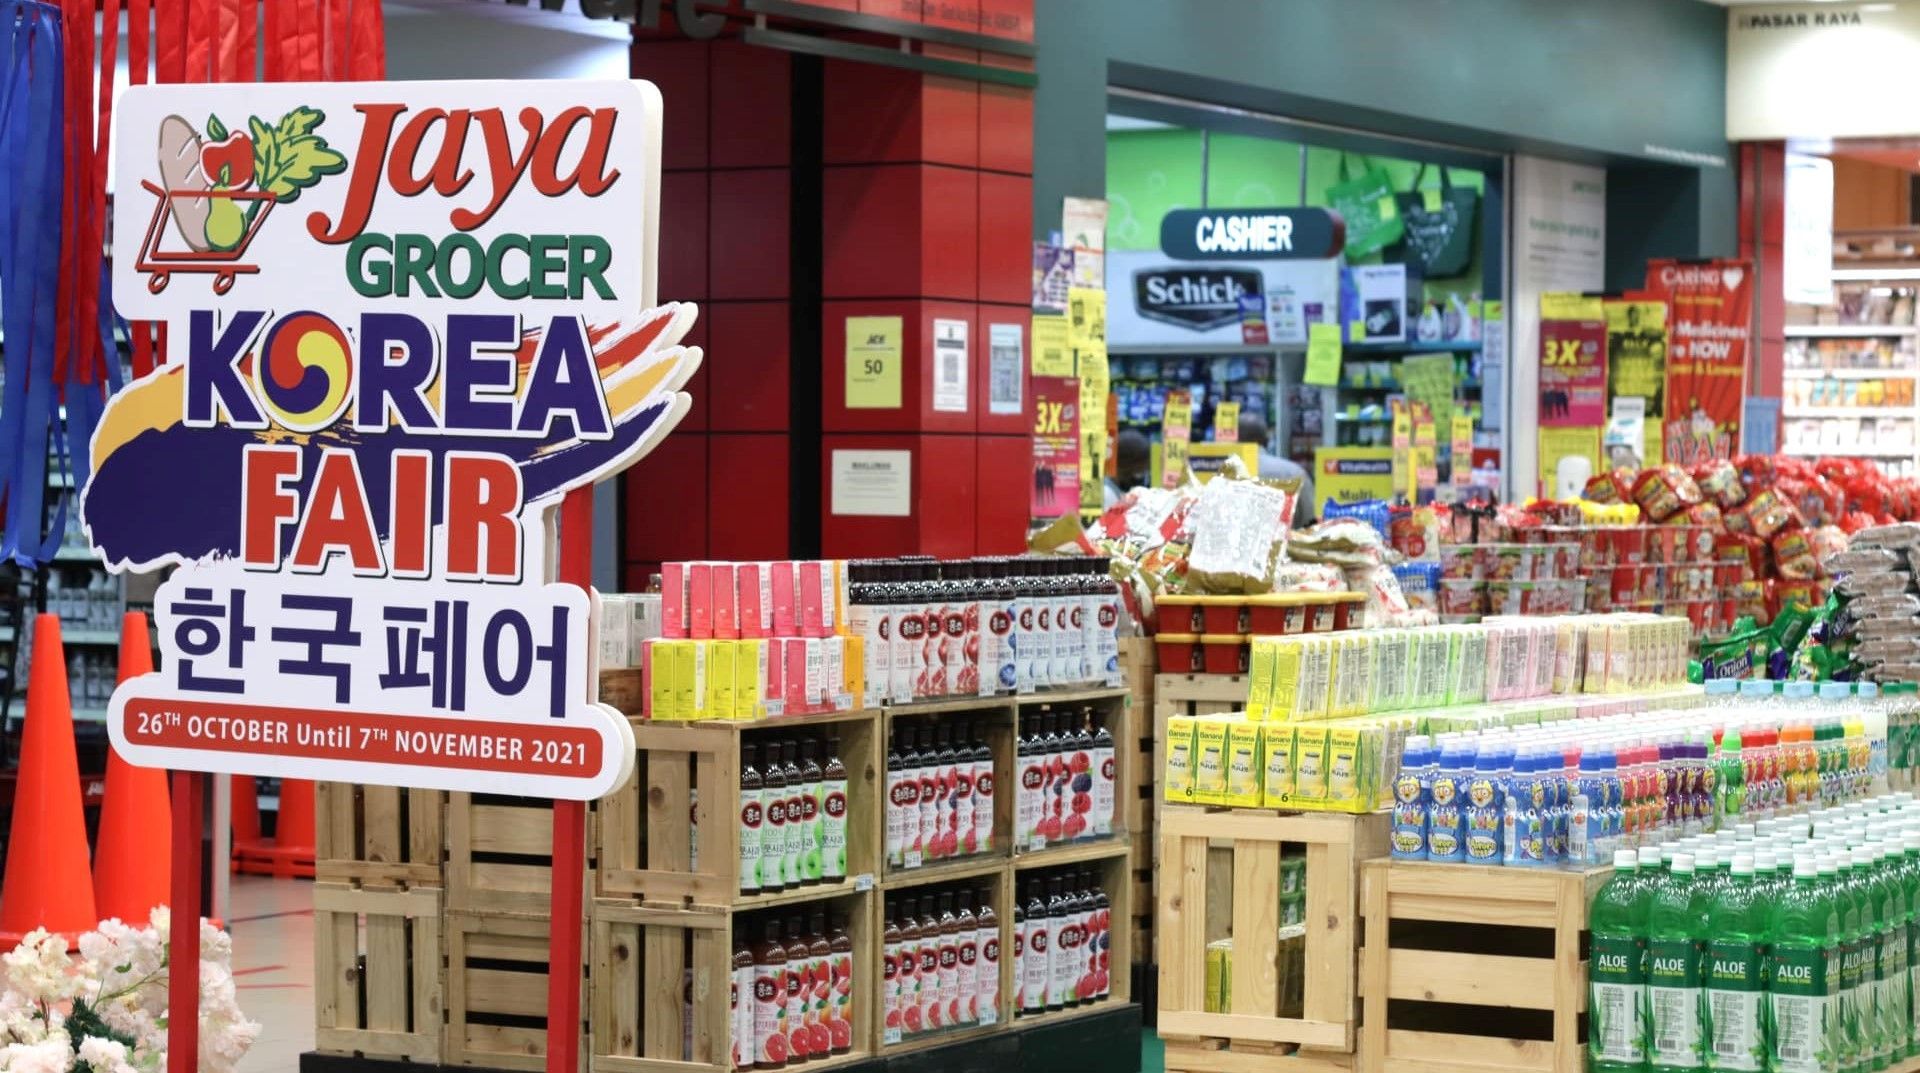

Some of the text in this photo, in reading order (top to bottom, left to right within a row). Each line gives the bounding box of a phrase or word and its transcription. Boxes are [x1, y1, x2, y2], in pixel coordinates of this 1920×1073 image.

[1750, 10, 1862, 29] PASAR RAYA
[306, 102, 620, 244] Jaya
[1195, 215, 1294, 252] CASHIER
[344, 231, 619, 301] GROCER
[1145, 276, 1245, 305] Schick
[1541, 339, 1582, 366] 3X
[1689, 340, 1731, 360] NOW
[186, 310, 612, 437] KOREA
[864, 359, 883, 375] 50
[243, 448, 521, 579] FAIR
[1719, 656, 1748, 677] Onion
[136, 711, 588, 766] 26TH OCTOBER Until 7TH NOVEMBER 2021
[1168, 730, 1191, 738] Banana
[1200, 732, 1223, 740] Banana
[1231, 734, 1255, 743] Banana
[1267, 736, 1291, 744] Banana
[1299, 737, 1323, 745] Banana
[1332, 739, 1356, 747] Banana
[1185, 786, 1193, 796] 6
[1281, 792, 1289, 803] 6
[1598, 954, 1627, 967] ALOE
[1654, 957, 1685, 971] ALOE
[1713, 960, 1746, 974] ALOE
[1777, 964, 1811, 979] ALOE
